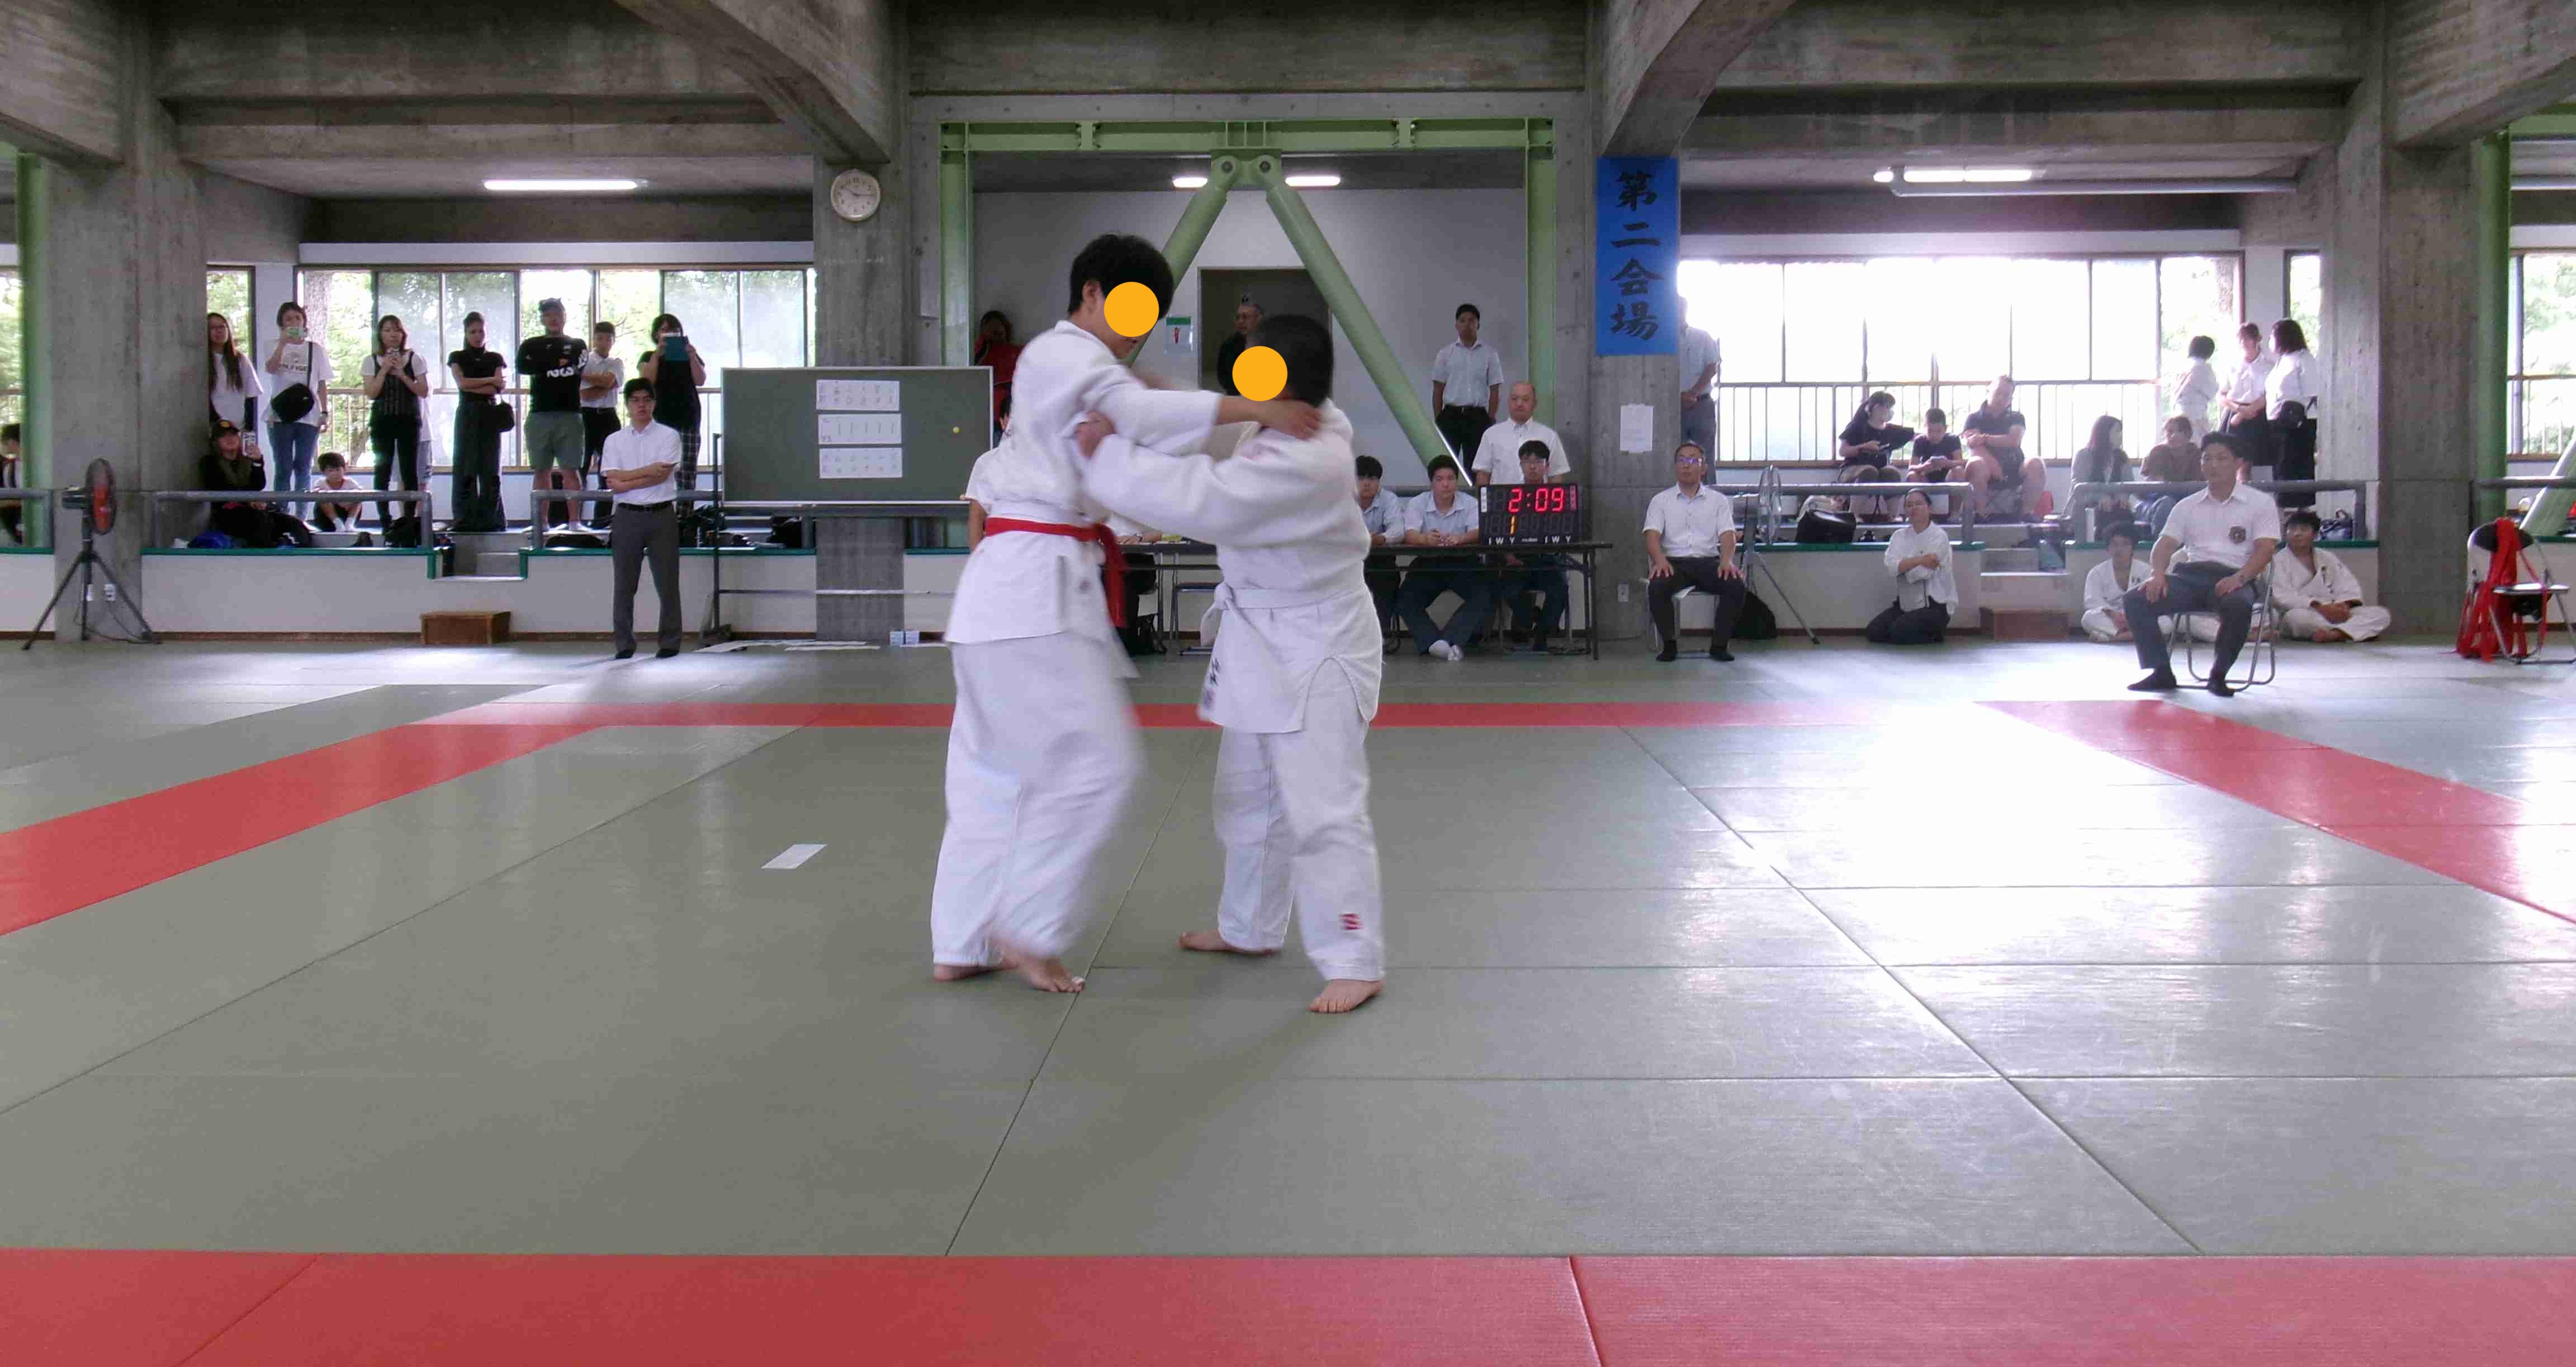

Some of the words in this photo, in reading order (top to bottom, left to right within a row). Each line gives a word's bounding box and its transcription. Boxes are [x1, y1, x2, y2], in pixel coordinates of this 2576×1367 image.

[1610, 169, 1664, 340] 第二会場
[1508, 487, 1565, 512] 2:09
[1495, 537, 1504, 545] W
[1509, 537, 1515, 545] Y
[1552, 536, 1560, 544] W
